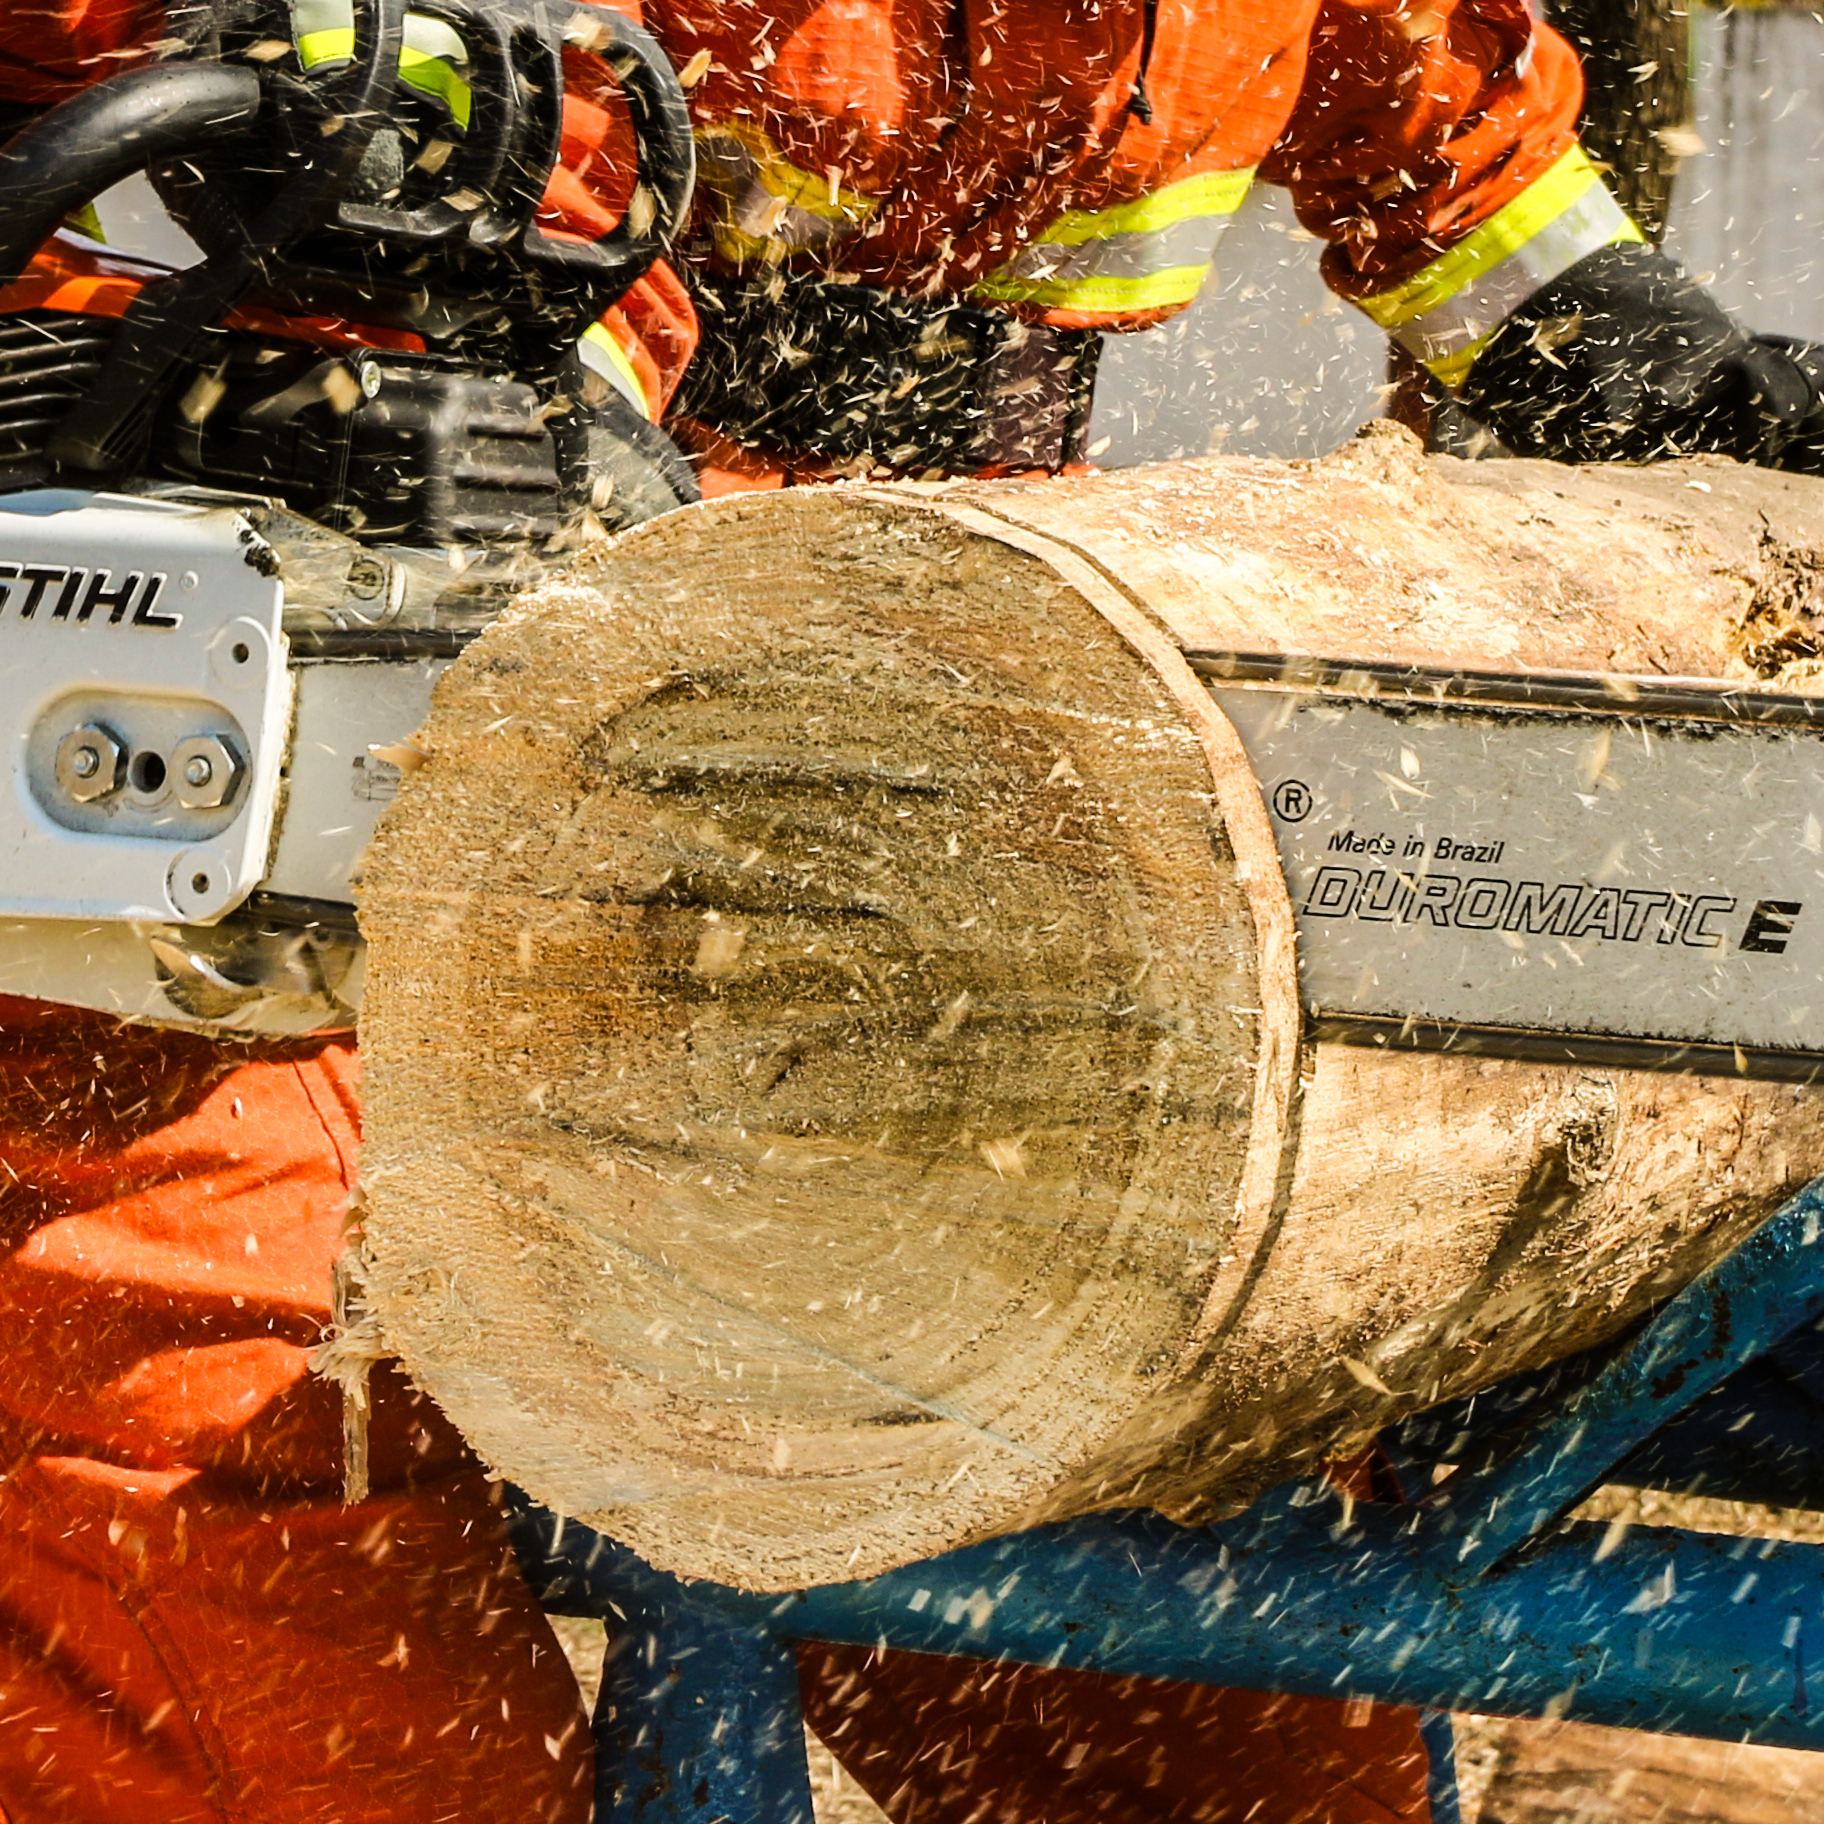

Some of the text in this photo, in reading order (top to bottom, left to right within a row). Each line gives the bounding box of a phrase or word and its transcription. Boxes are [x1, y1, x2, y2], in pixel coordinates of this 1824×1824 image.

[1327, 830, 1505, 864] Made in Brazil
[1301, 866, 1802, 954] DUROMATIC E
